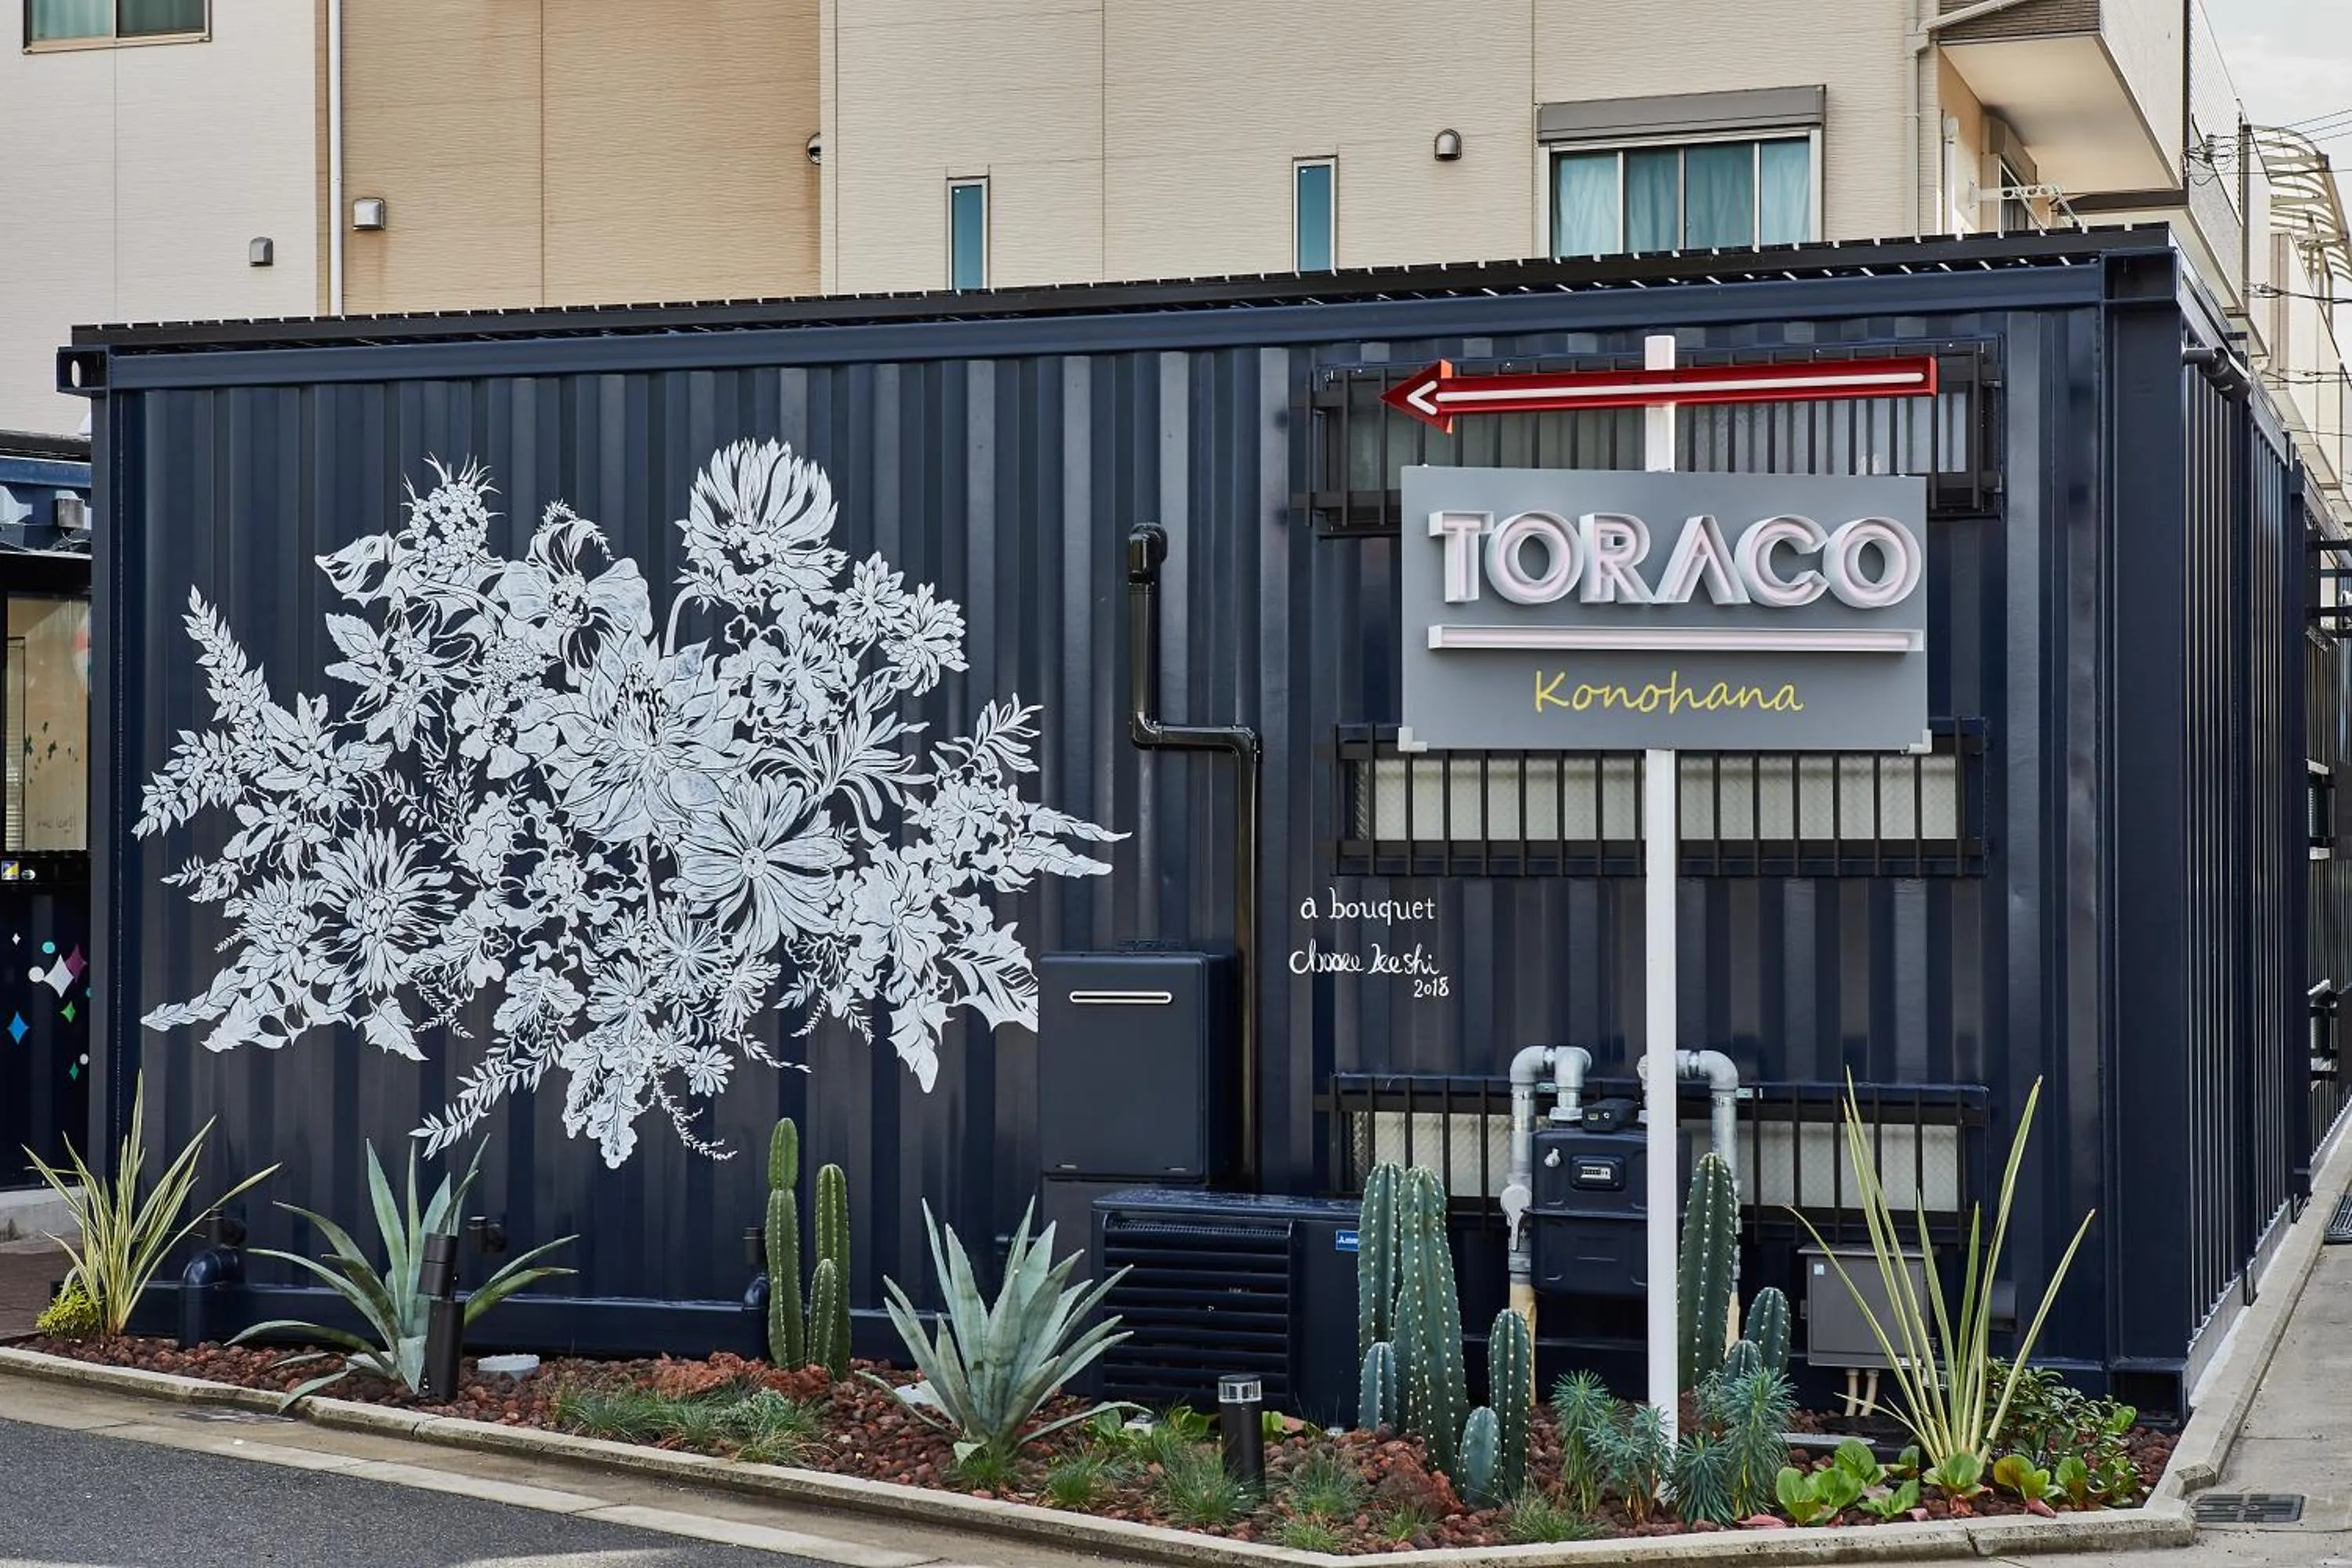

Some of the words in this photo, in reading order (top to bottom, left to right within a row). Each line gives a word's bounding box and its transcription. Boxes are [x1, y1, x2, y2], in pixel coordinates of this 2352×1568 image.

[1428, 510, 1922, 608] TORACO
[1534, 670, 1804, 715] Konohana
[1300, 896, 1319, 920] a
[1328, 887, 1436, 926] bouquet
[1414, 975, 1450, 998] 2018
